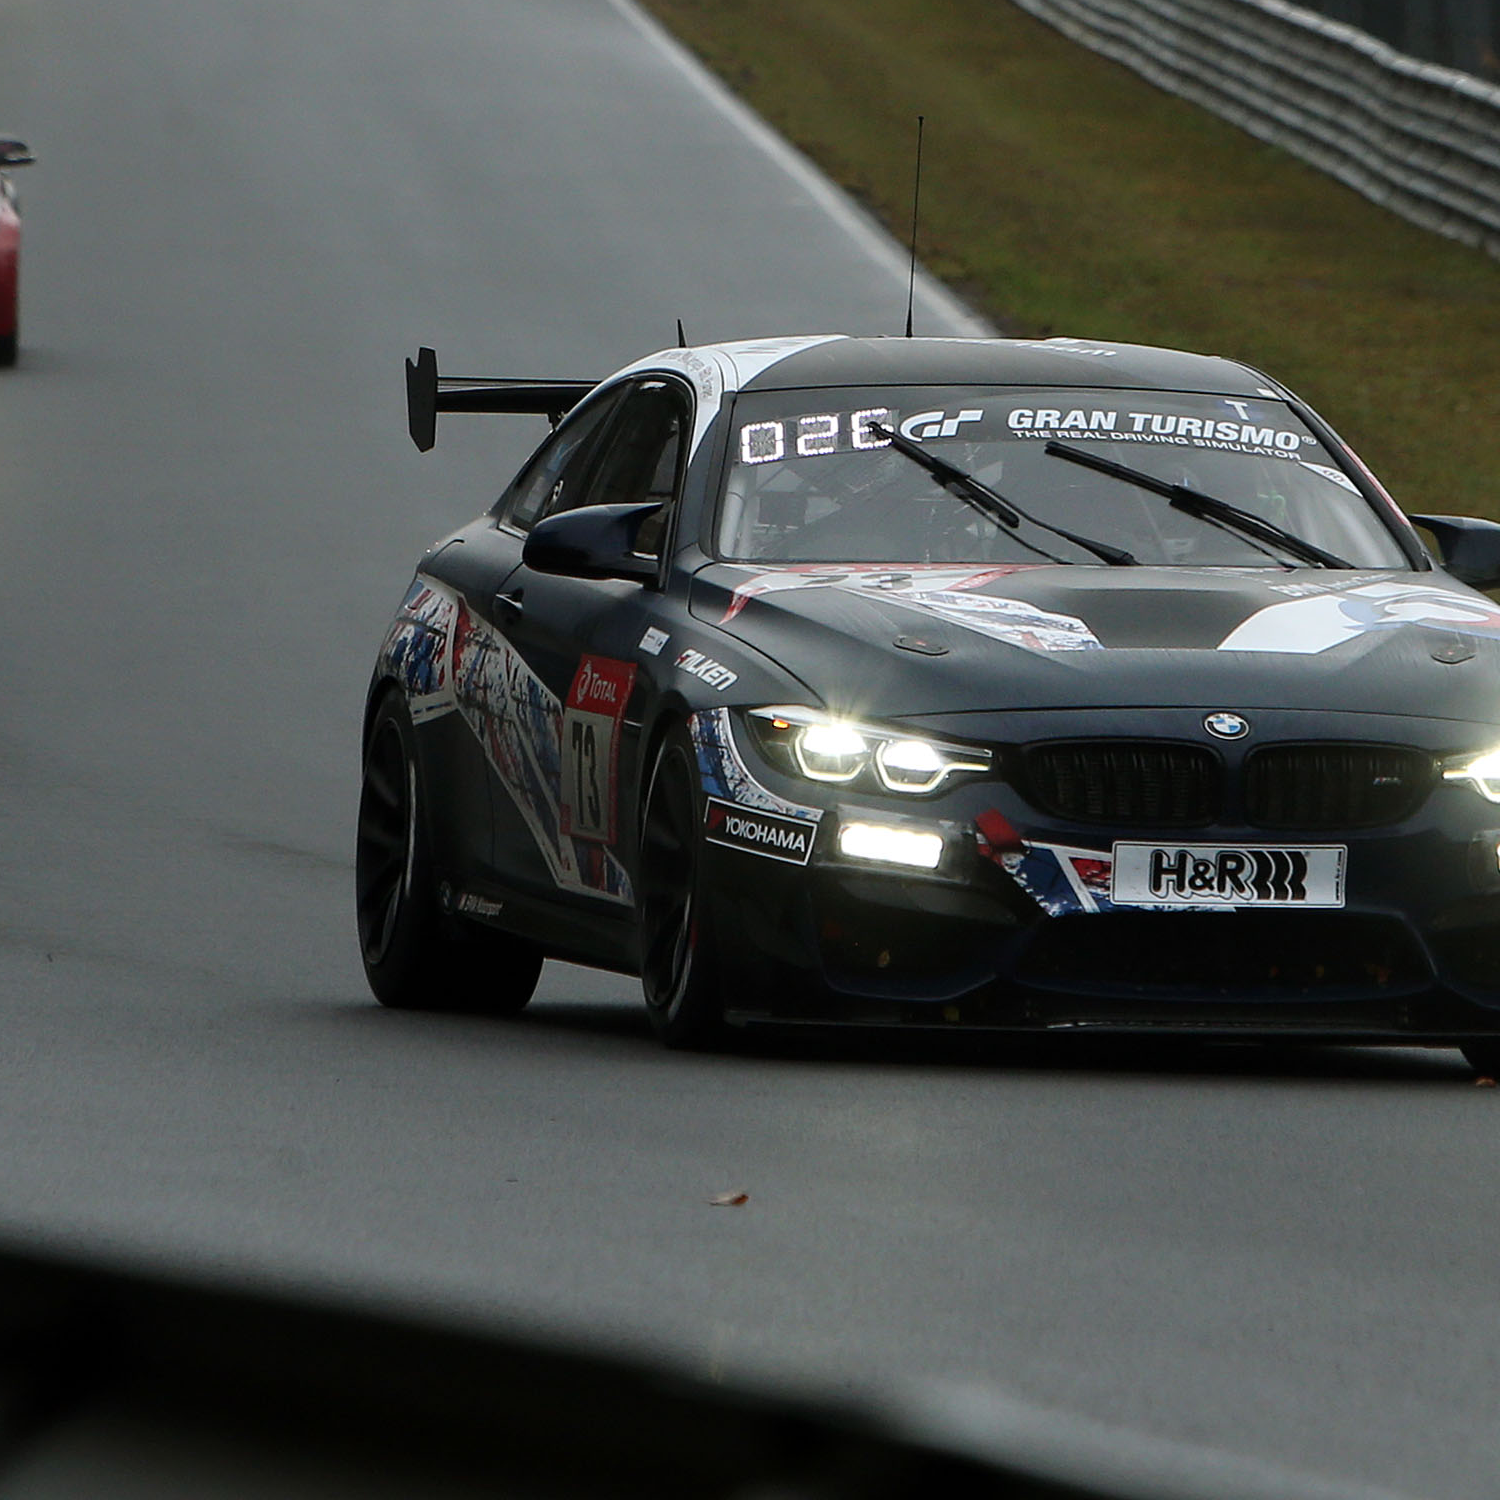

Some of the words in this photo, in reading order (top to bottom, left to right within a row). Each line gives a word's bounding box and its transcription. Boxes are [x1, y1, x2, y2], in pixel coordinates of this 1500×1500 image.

[900, 409, 984, 443] GT
[1007, 408, 1117, 432] GRAN
[1012, 430, 1052, 440] THE
[1056, 431, 1107, 442] REAL
[1111, 431, 1189, 446] DRIVING
[1192, 437, 1301, 461] SIMULATOR
[589, 672, 617, 703] TOTAL
[674, 648, 739, 691] FALKEN
[572, 720, 601, 831] 73
[724, 815, 806, 853] YOKOHAMA
[1151, 850, 1254, 901] H&R
